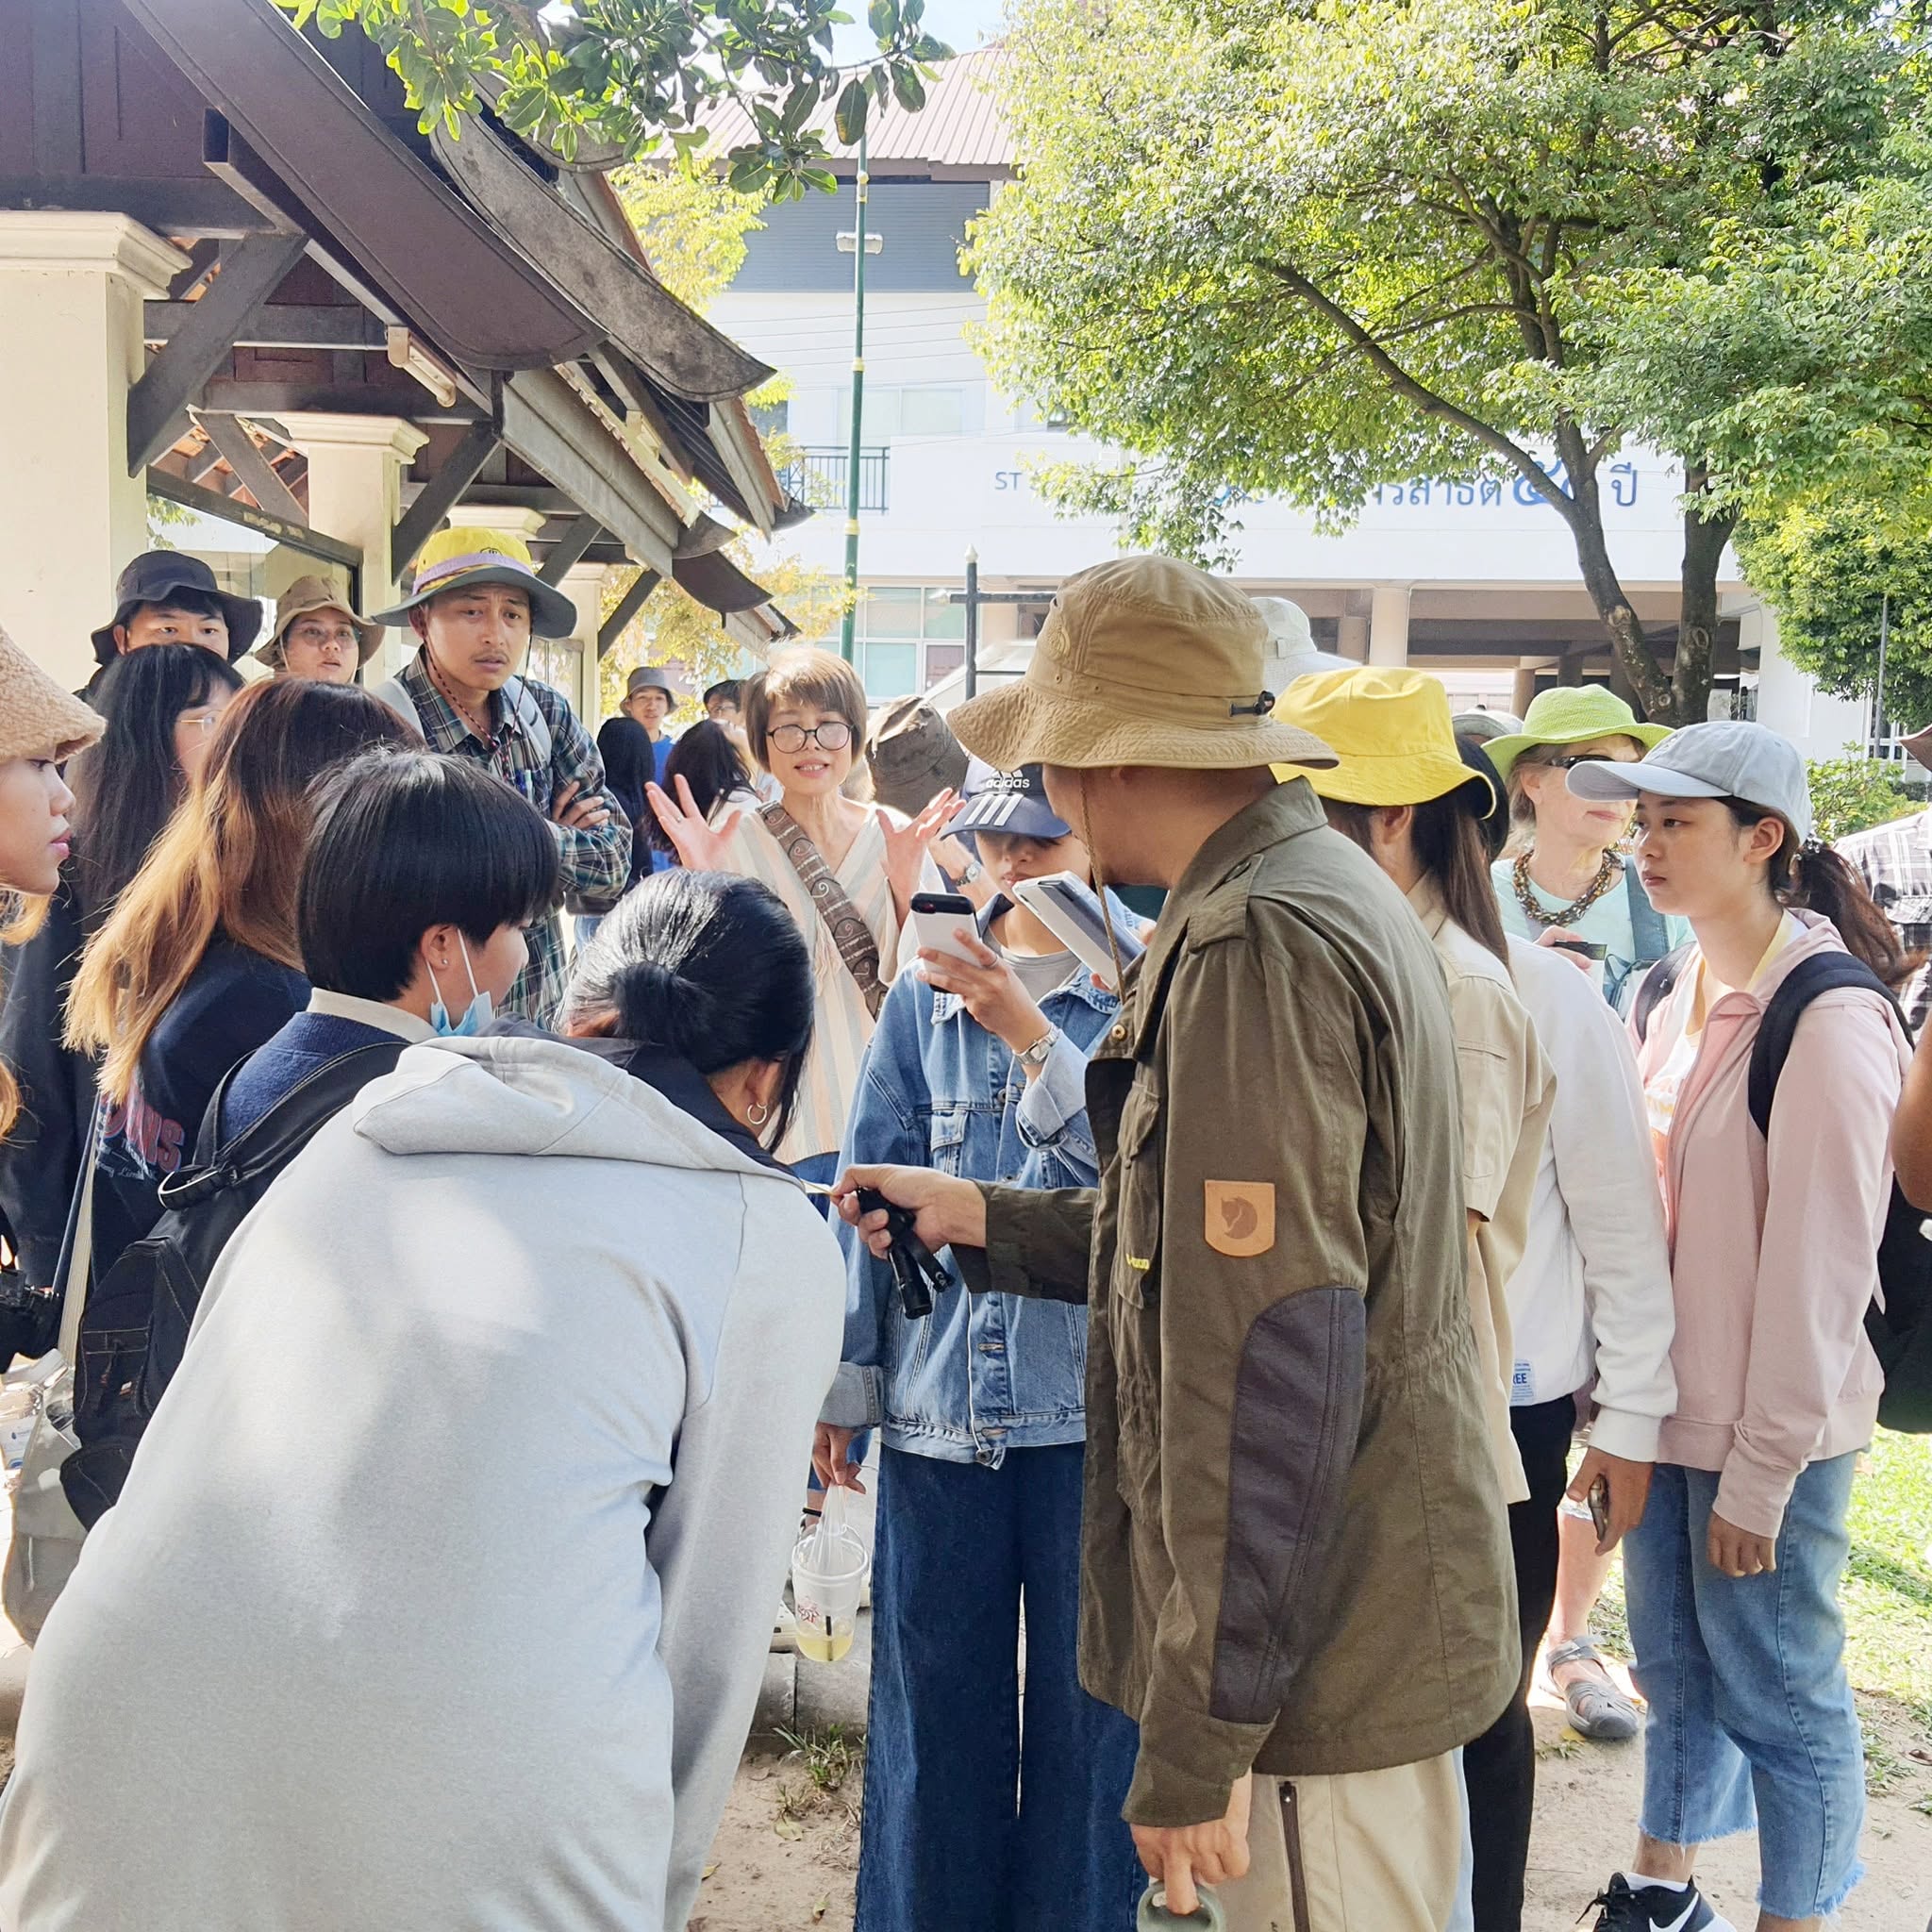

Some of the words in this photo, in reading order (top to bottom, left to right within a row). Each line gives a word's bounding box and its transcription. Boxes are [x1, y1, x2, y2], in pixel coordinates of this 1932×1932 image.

[994, 471, 1023, 491] ST
[1610, 461, 1638, 507] ปี
[985, 775, 1030, 789] adidas
